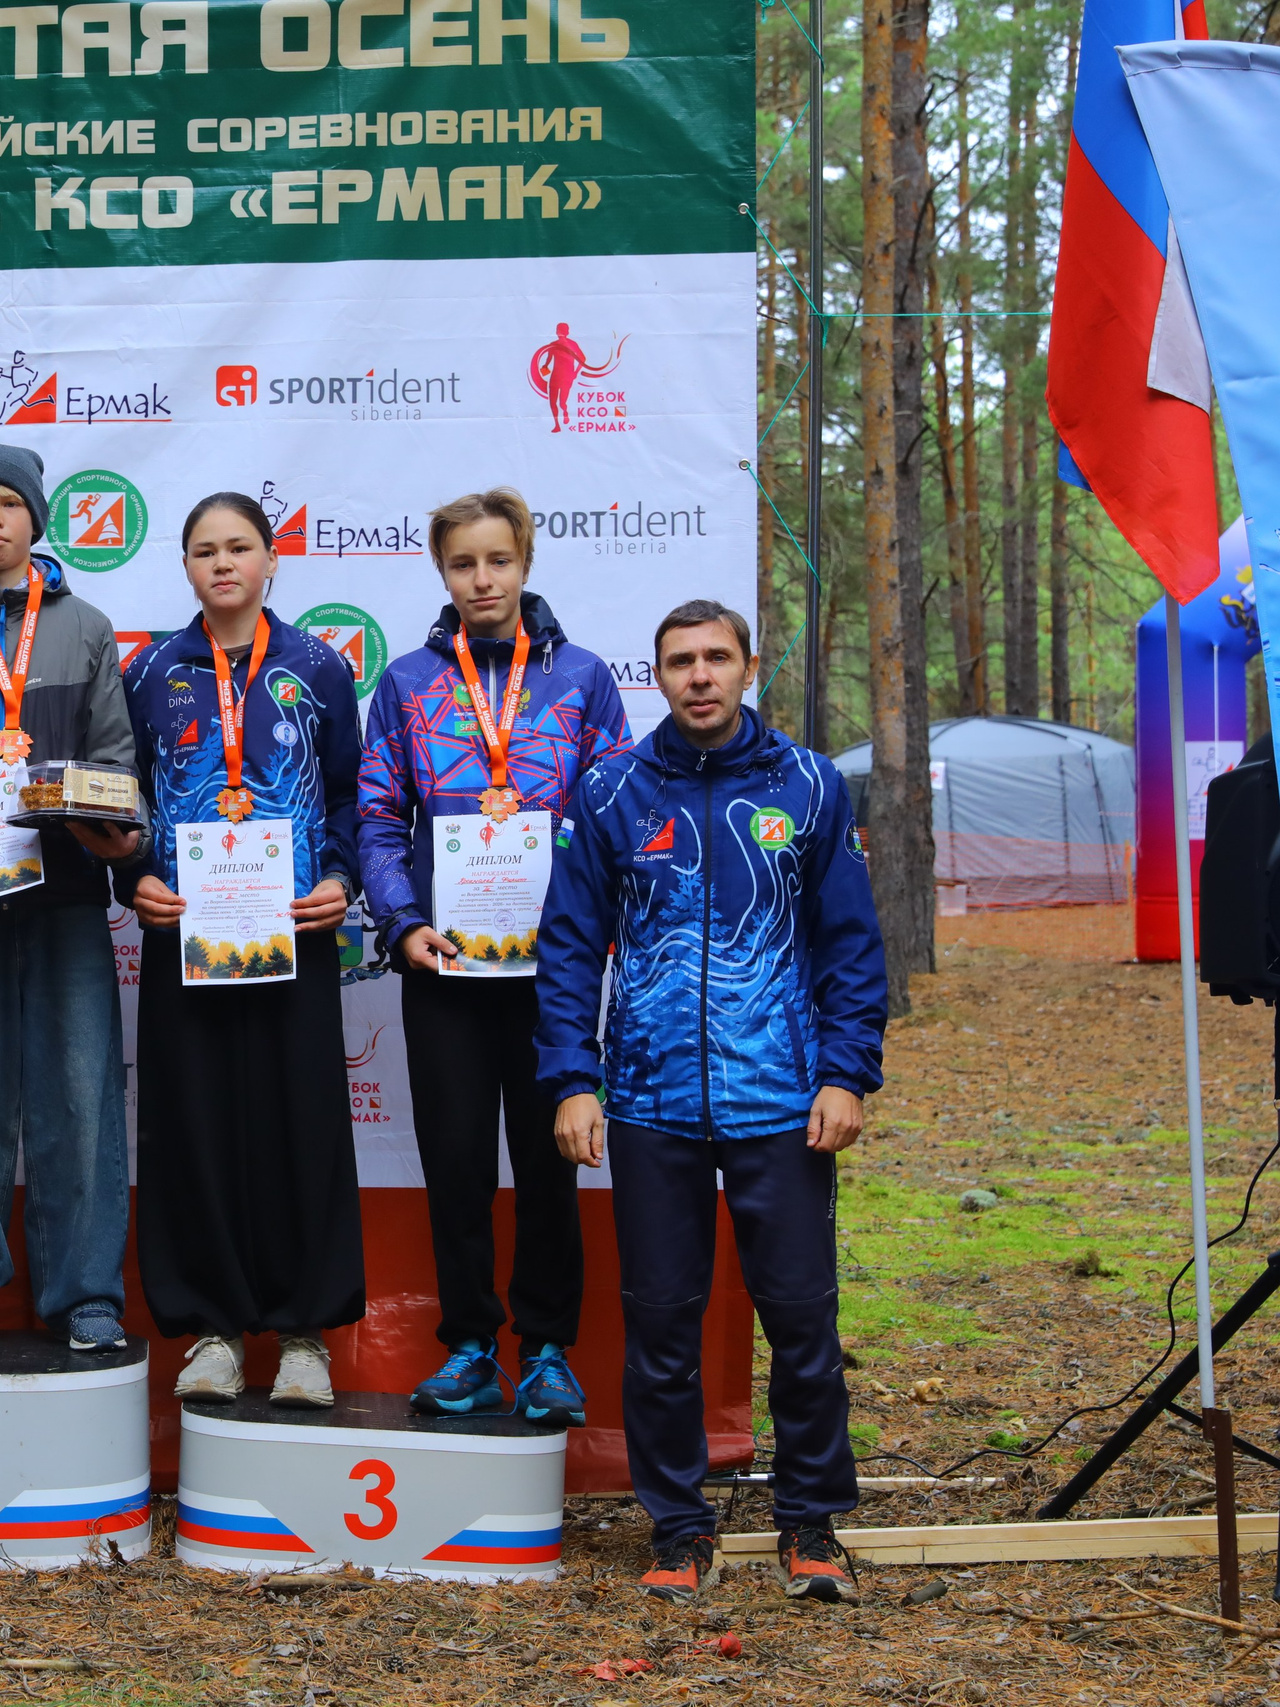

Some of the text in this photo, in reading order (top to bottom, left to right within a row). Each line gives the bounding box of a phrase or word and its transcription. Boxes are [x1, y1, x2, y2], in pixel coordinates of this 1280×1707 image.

[260, 0, 630, 72] ОСЕНЬ
[187, 106, 602, 153] СОРЕВНОВАНИЯ
[35, 175, 194, 231] КСО
[230, 164, 602, 225] «ЕРМАК»
[269, 368, 461, 405] SPORTident
[65, 382, 172, 425] Ермак
[577, 391, 626, 403] КУБОК
[350, 406, 422, 421] siberia
[577, 406, 608, 418] КСО
[568, 422, 636, 433] «ЕРМАК»
[49, 483, 73, 522] ФЕДЕРАЦИЯ
[76, 474, 127, 490] СПОРТИВНОГО
[531, 501, 707, 539] PORTident
[315, 515, 422, 558] Ермак
[594, 540, 667, 555] siberia
[19, 639, 31, 675] ЗОЛОТАЯ
[26, 611, 37, 637] ОСЕНЬ
[315, 607, 383, 690] СПОРТИВНОГО ОРИЕНТИРОВАНИЯ
[168, 695, 195, 708] DINA
[505, 664, 524, 730] ЗОЛОТАЯ ОСЕНЬ
[223, 679, 236, 746] ЗОЛОТАЯ ОСЕНЬ
[475, 682, 500, 746] ЗОЛОТАЯ ОСЕНЬ
[460, 723, 477, 731] SFR
[16, 735, 24, 745] 1
[238, 792, 247, 801] 3
[504, 791, 513, 802] 3
[466, 855, 522, 867] ДИПЛОМ
[209, 863, 265, 875] ДИПЛОМ
[113, 945, 139, 956] БОК
[349, 1082, 381, 1093] БОК
[351, 1112, 391, 1123] МАК»
[344, 1459, 398, 1541] 3
